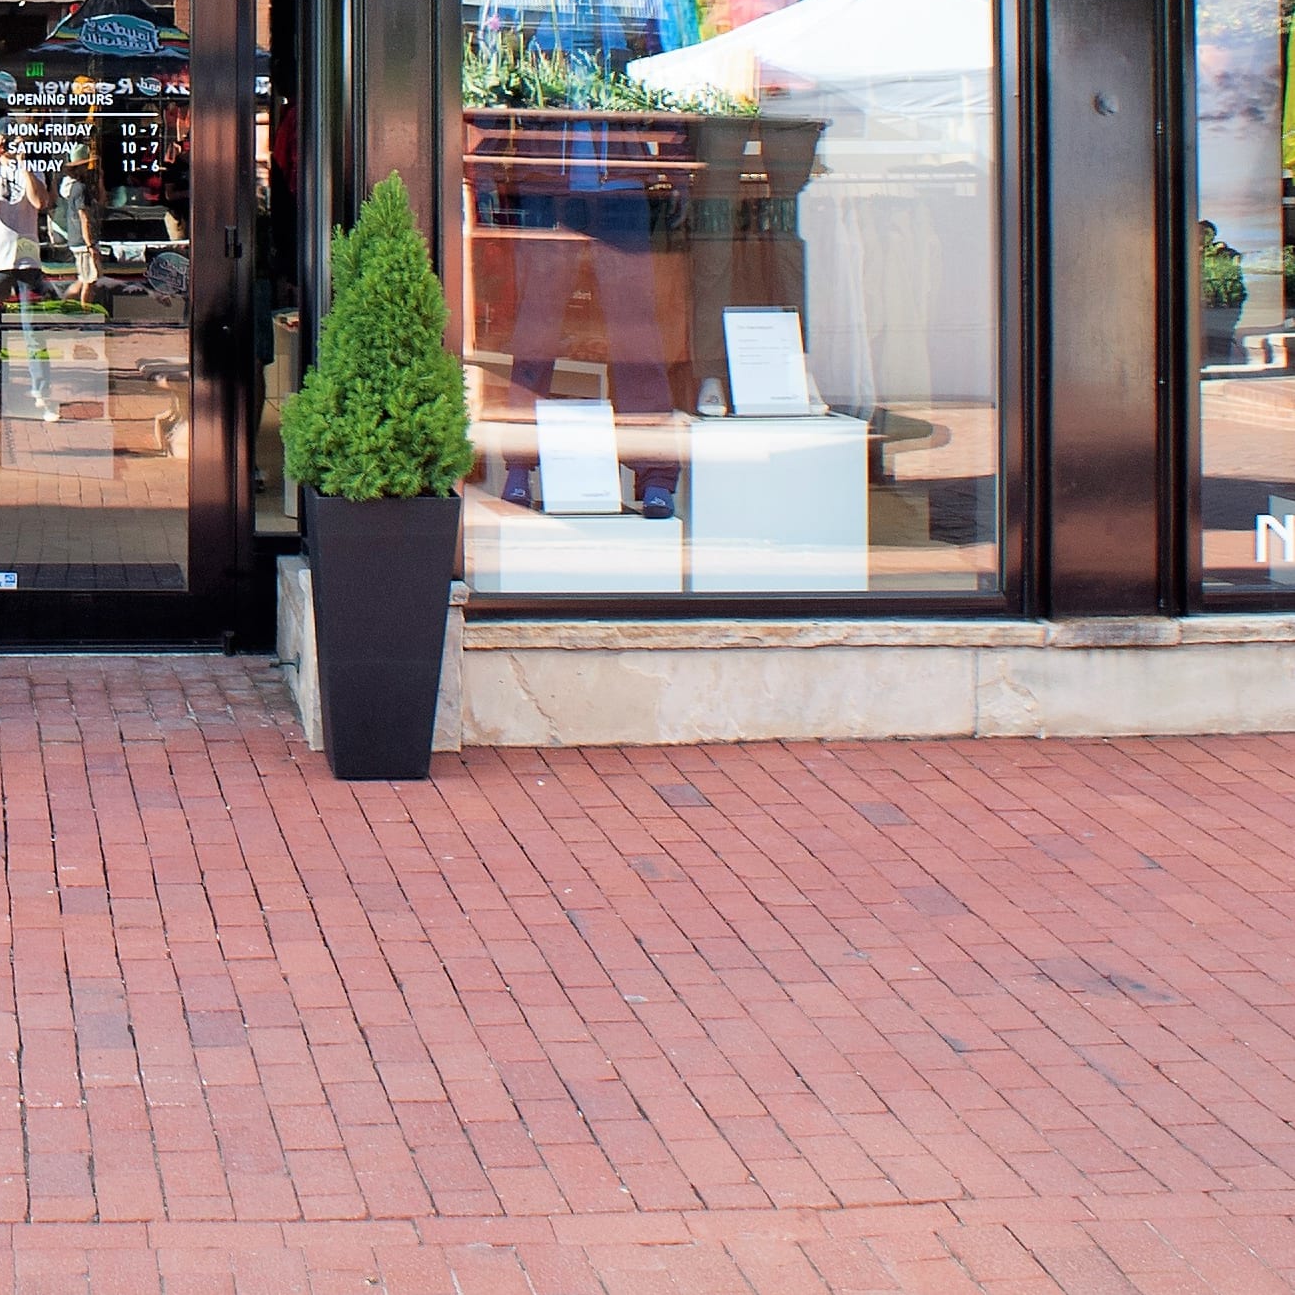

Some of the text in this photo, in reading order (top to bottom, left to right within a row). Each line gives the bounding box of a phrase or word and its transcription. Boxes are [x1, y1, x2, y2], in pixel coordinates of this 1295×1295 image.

[7, 94, 114, 106] OPENING HOURS
[7, 123, 93, 136] MON-FRIDAY
[121, 123, 136, 136] 10
[149, 123, 159, 136] 7
[7, 141, 78, 154] SATURDAY
[121, 141, 136, 154] 10
[150, 141, 159, 154] 7
[123, 159, 136, 172] 11
[151, 159, 160, 172] 6
